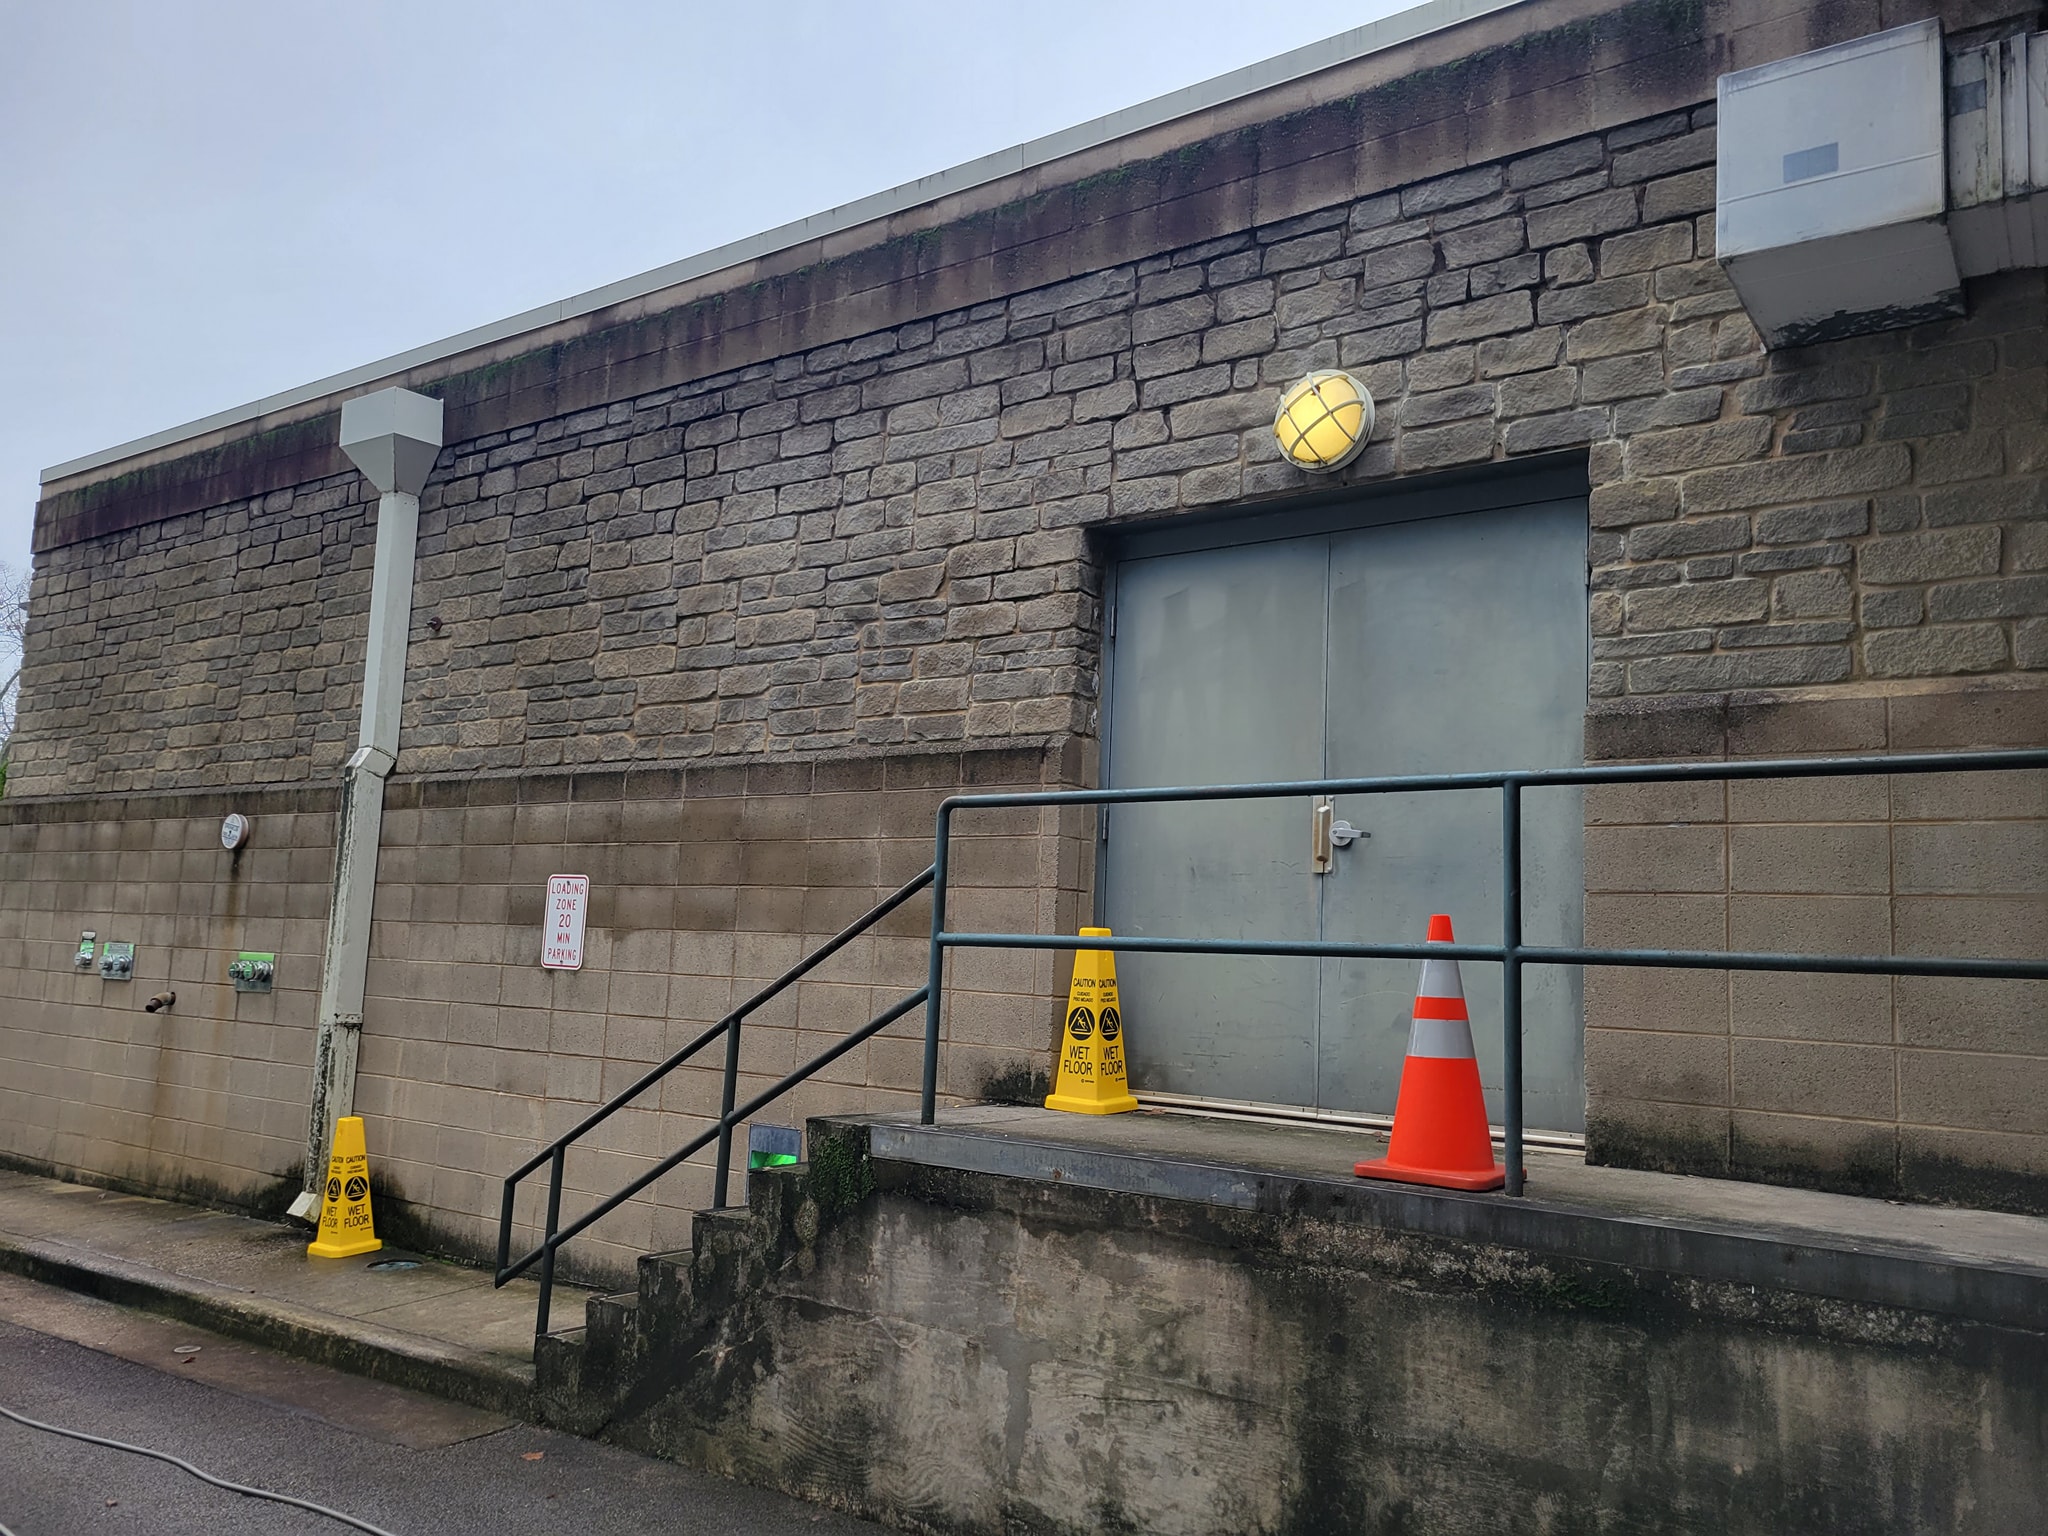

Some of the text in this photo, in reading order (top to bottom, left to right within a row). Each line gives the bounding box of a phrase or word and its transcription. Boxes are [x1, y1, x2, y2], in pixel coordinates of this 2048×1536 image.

[551, 882, 584, 895] LOADING
[556, 899, 577, 910] ZONE
[559, 914, 571, 928] 20
[557, 932, 570, 944] MIN
[547, 948, 577, 960] PARKING
[1073, 978, 1096, 987] CAUTION
[1099, 978, 1117, 988] CAUTION
[1070, 1045, 1090, 1060] WET
[1103, 1045, 1119, 1060] WET
[1064, 1060, 1093, 1075] FLOOR
[1101, 1060, 1123, 1076] FLOOR
[346, 1155, 365, 1163] CAUTION
[326, 1206, 337, 1216] WET
[348, 1203, 365, 1216] WET
[323, 1217, 338, 1228] FLOOR
[344, 1214, 369, 1228] FLOOR
